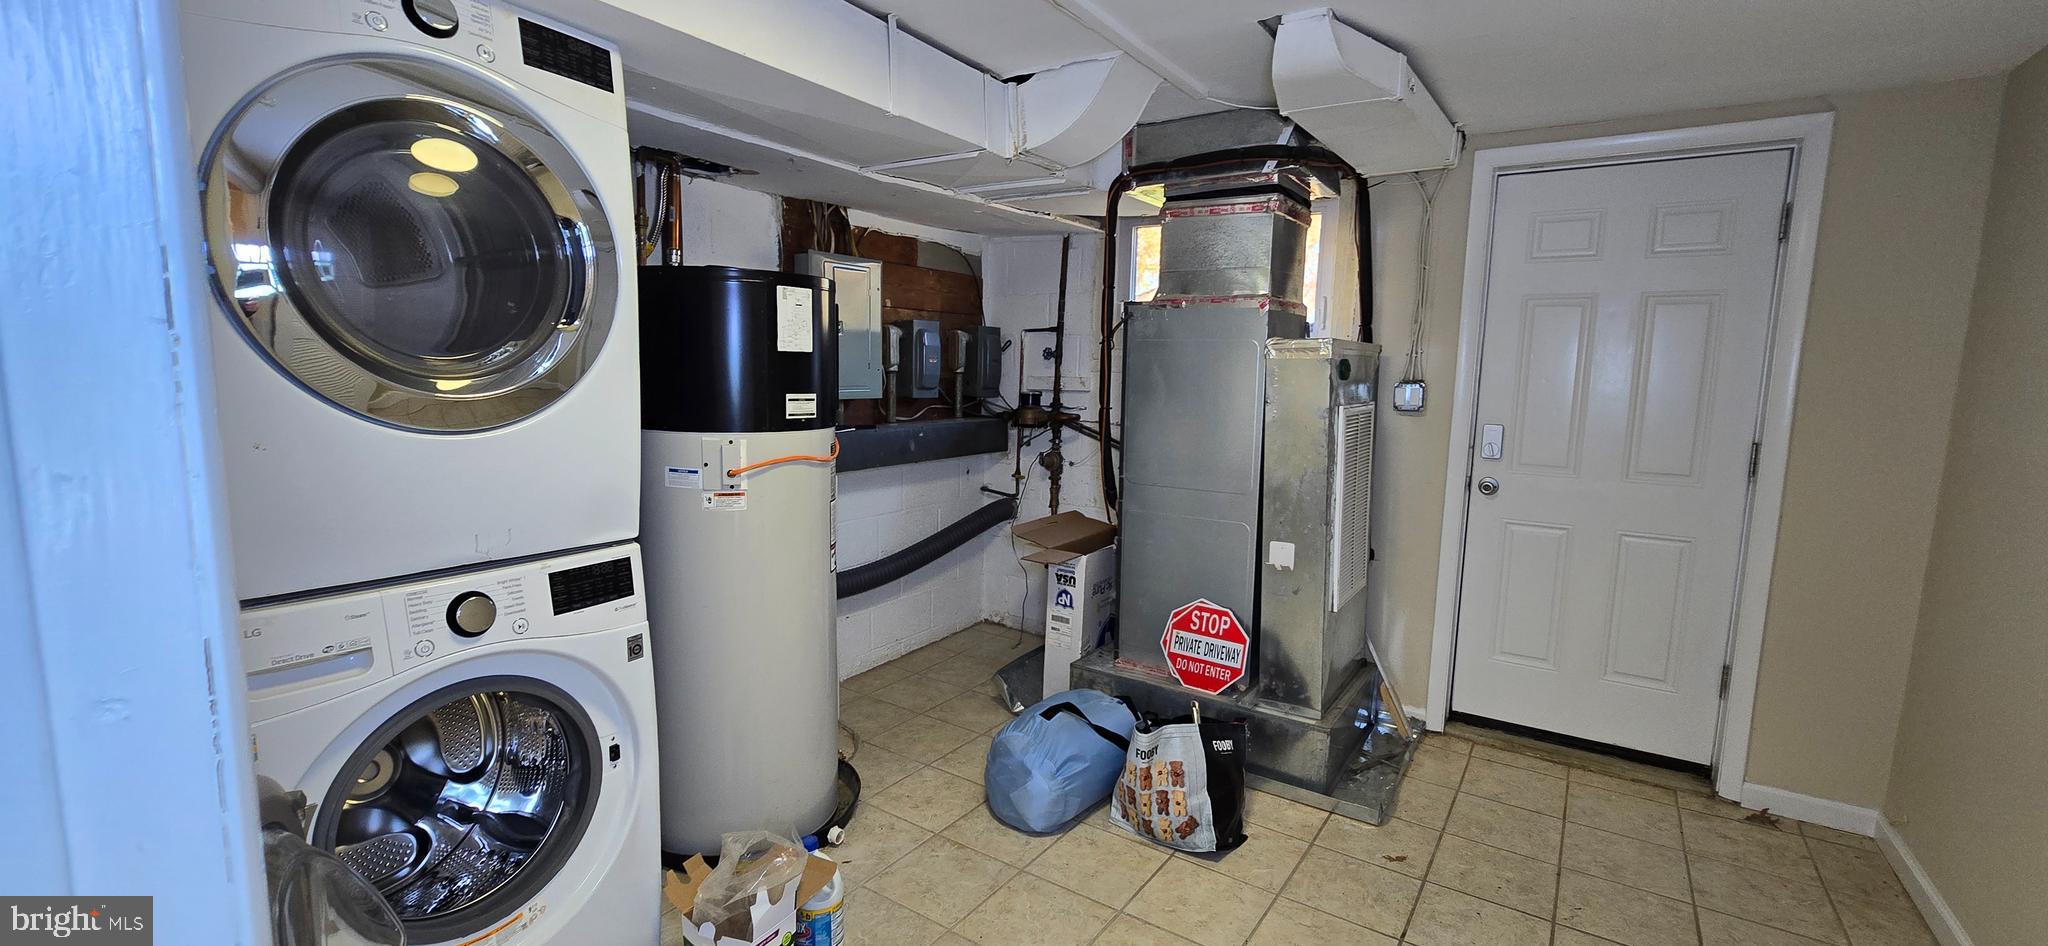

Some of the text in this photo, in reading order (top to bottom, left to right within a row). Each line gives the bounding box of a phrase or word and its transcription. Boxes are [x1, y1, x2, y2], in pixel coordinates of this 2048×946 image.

[1055, 573, 1076, 586] USA
[1058, 593, 1071, 606] NP
[1190, 610, 1231, 636] STOP
[243, 628, 262, 639] LG
[1173, 635, 1241, 664] PRIVATE DRIVEWAY
[271, 655, 294, 667] Direct
[295, 652, 315, 662] Drive
[1176, 658, 1187, 670] DO
[1188, 660, 1205, 675] NOT
[1205, 664, 1231, 682] ENTER
[1212, 739, 1234, 751] FOOBY
